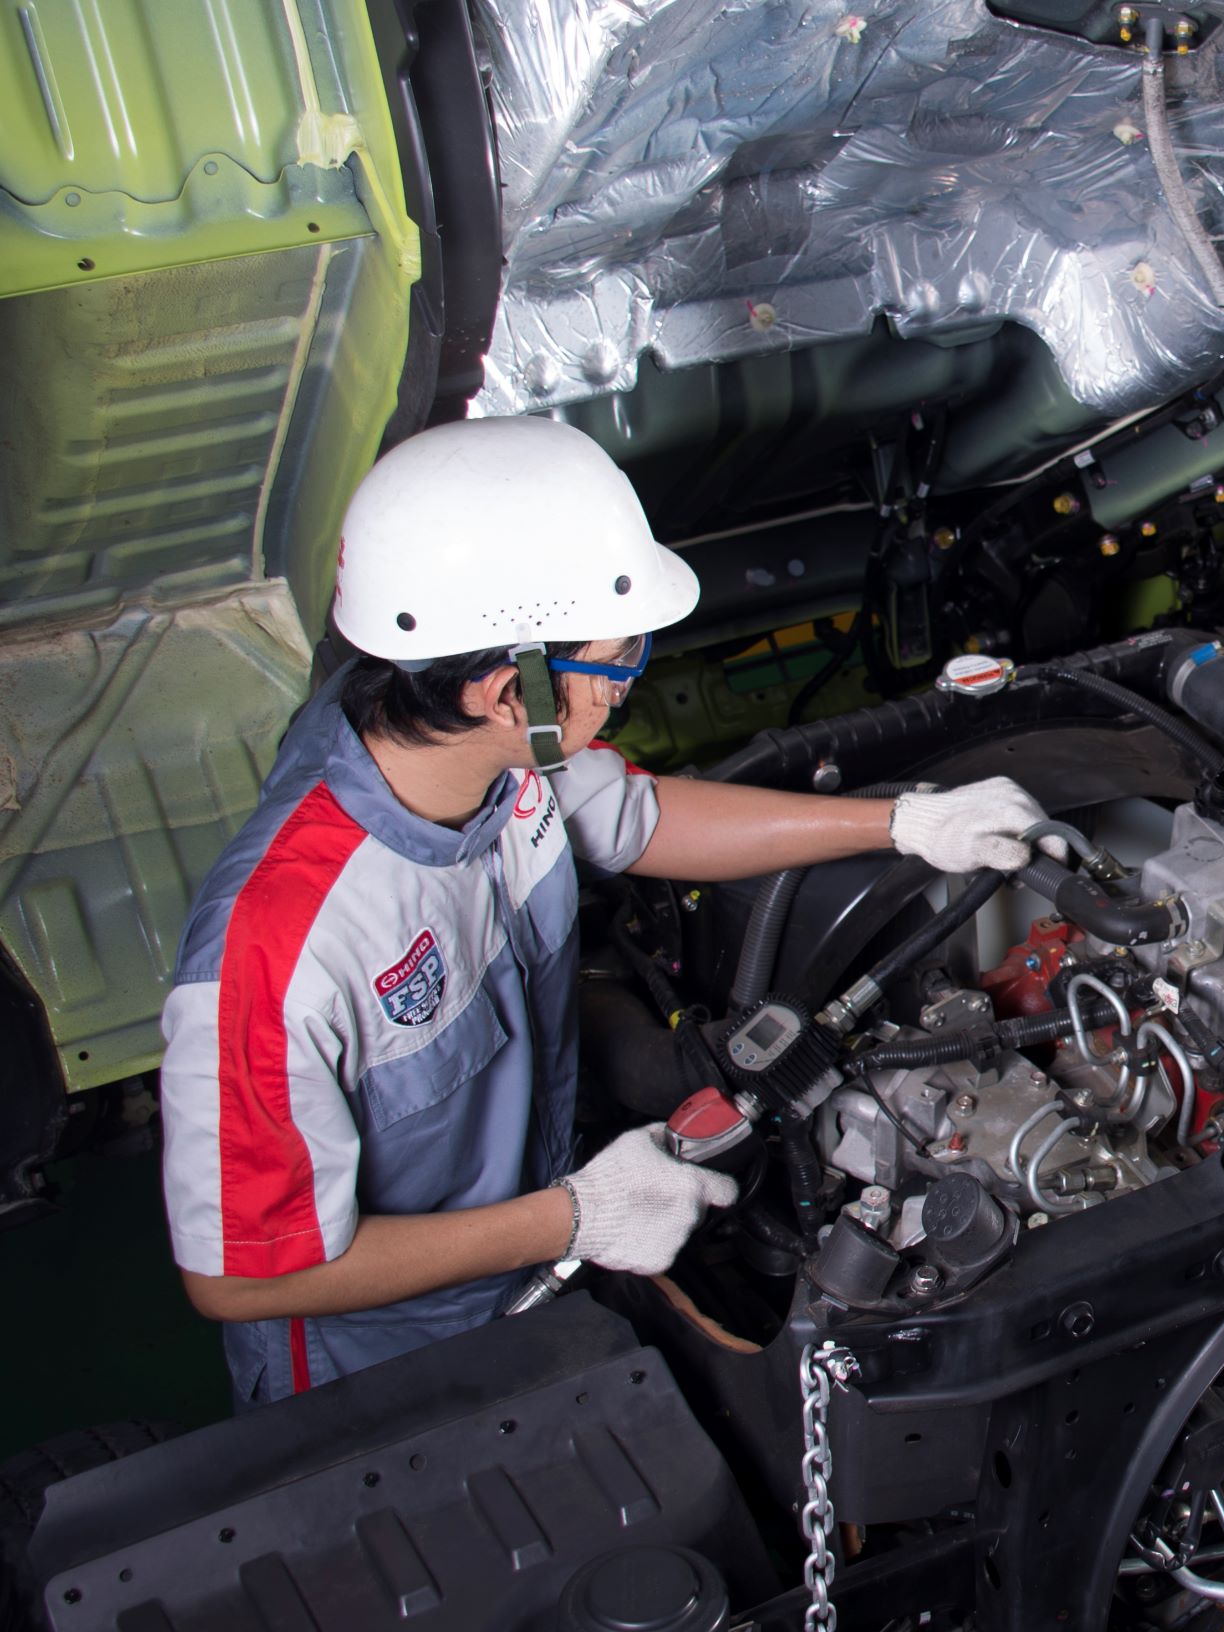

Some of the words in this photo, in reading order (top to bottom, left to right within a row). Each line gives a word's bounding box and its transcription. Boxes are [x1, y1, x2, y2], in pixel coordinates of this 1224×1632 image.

[530, 795, 556, 848] HINO
[398, 937, 430, 978] HINO
[387, 955, 440, 1015] FSP
